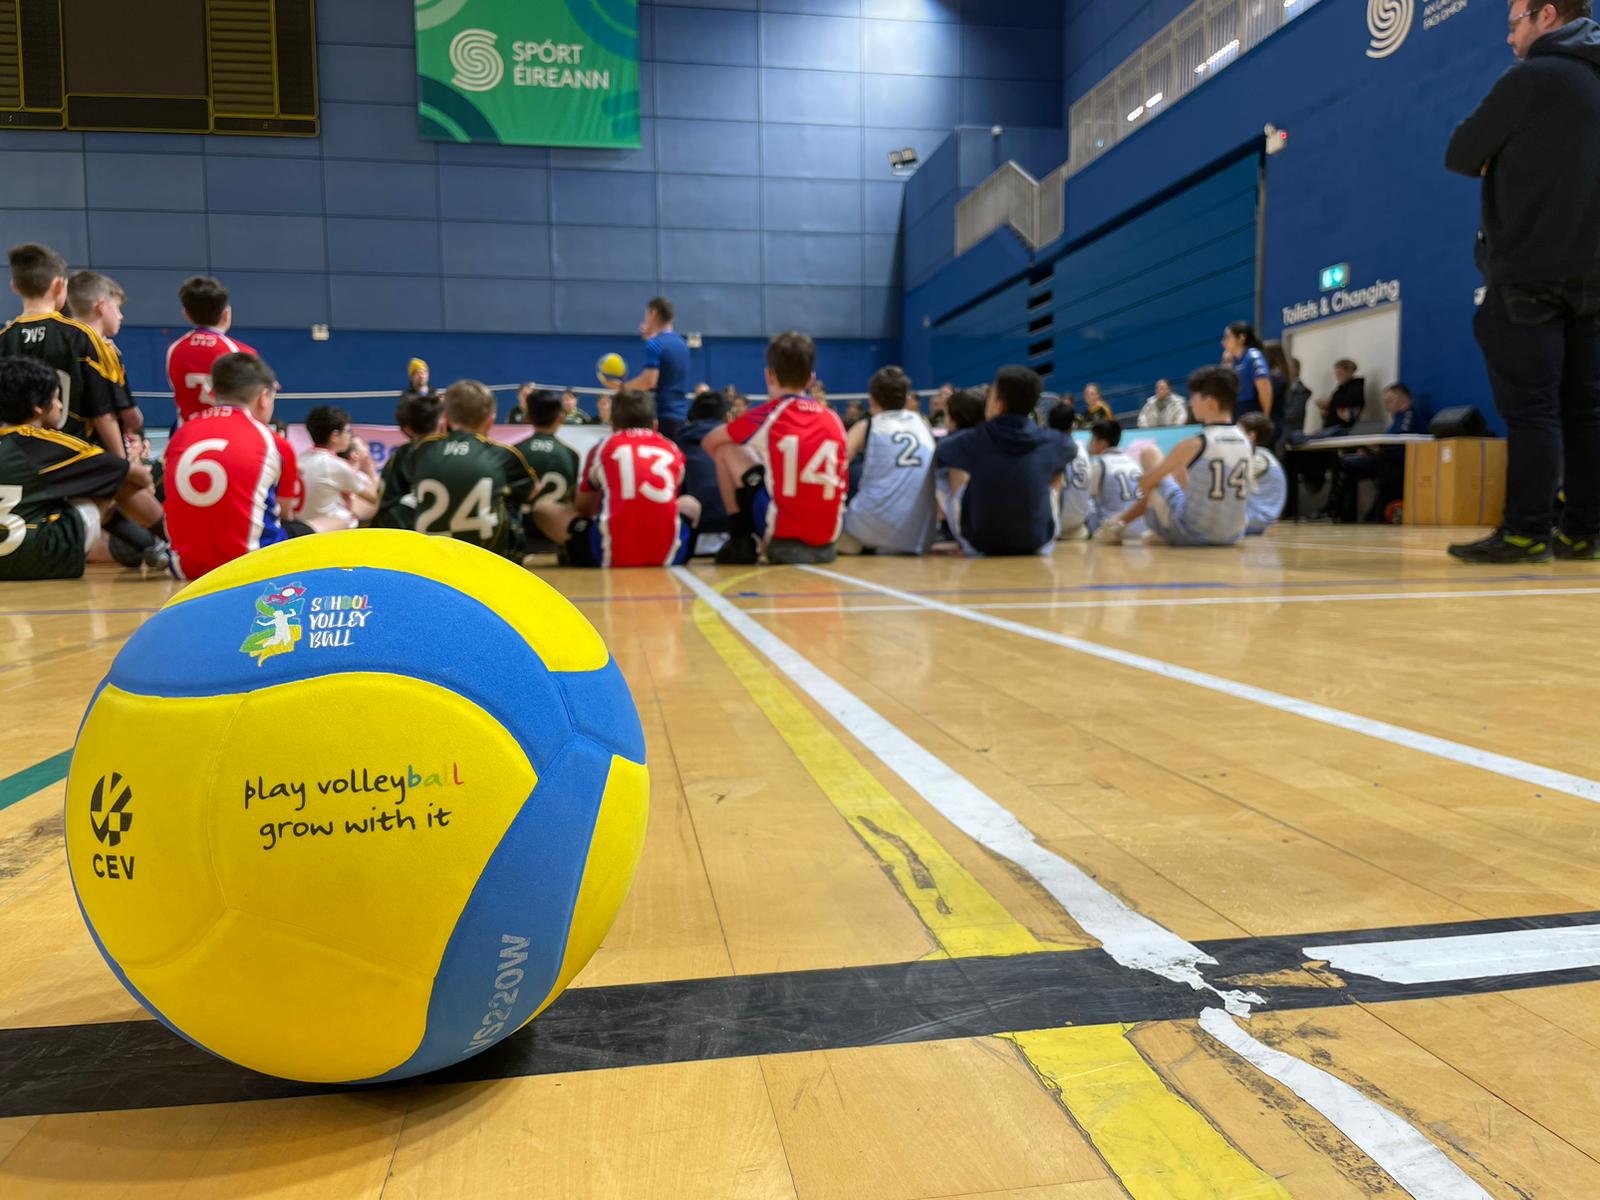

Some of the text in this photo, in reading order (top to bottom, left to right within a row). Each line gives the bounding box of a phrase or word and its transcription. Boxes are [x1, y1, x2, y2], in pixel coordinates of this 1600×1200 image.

[512, 38, 584, 64] SPÓRT
[513, 60, 610, 90] ÉIREANN
[1282, 279, 1400, 326] Toilets & Changing
[776, 434, 844, 500] 14
[891, 431, 922, 467] 2
[175, 437, 229, 508] 6
[610, 444, 675, 503] 13
[1208, 457, 1249, 500] 14
[415, 477, 498, 540] 24
[309, 610, 373, 630] VOLLEY
[311, 594, 372, 611] SCHOOL
[309, 629, 355, 648] BALL
[245, 762, 464, 811] play volleyball
[259, 802, 452, 850] grow with it
[92, 853, 135, 880] CEV
